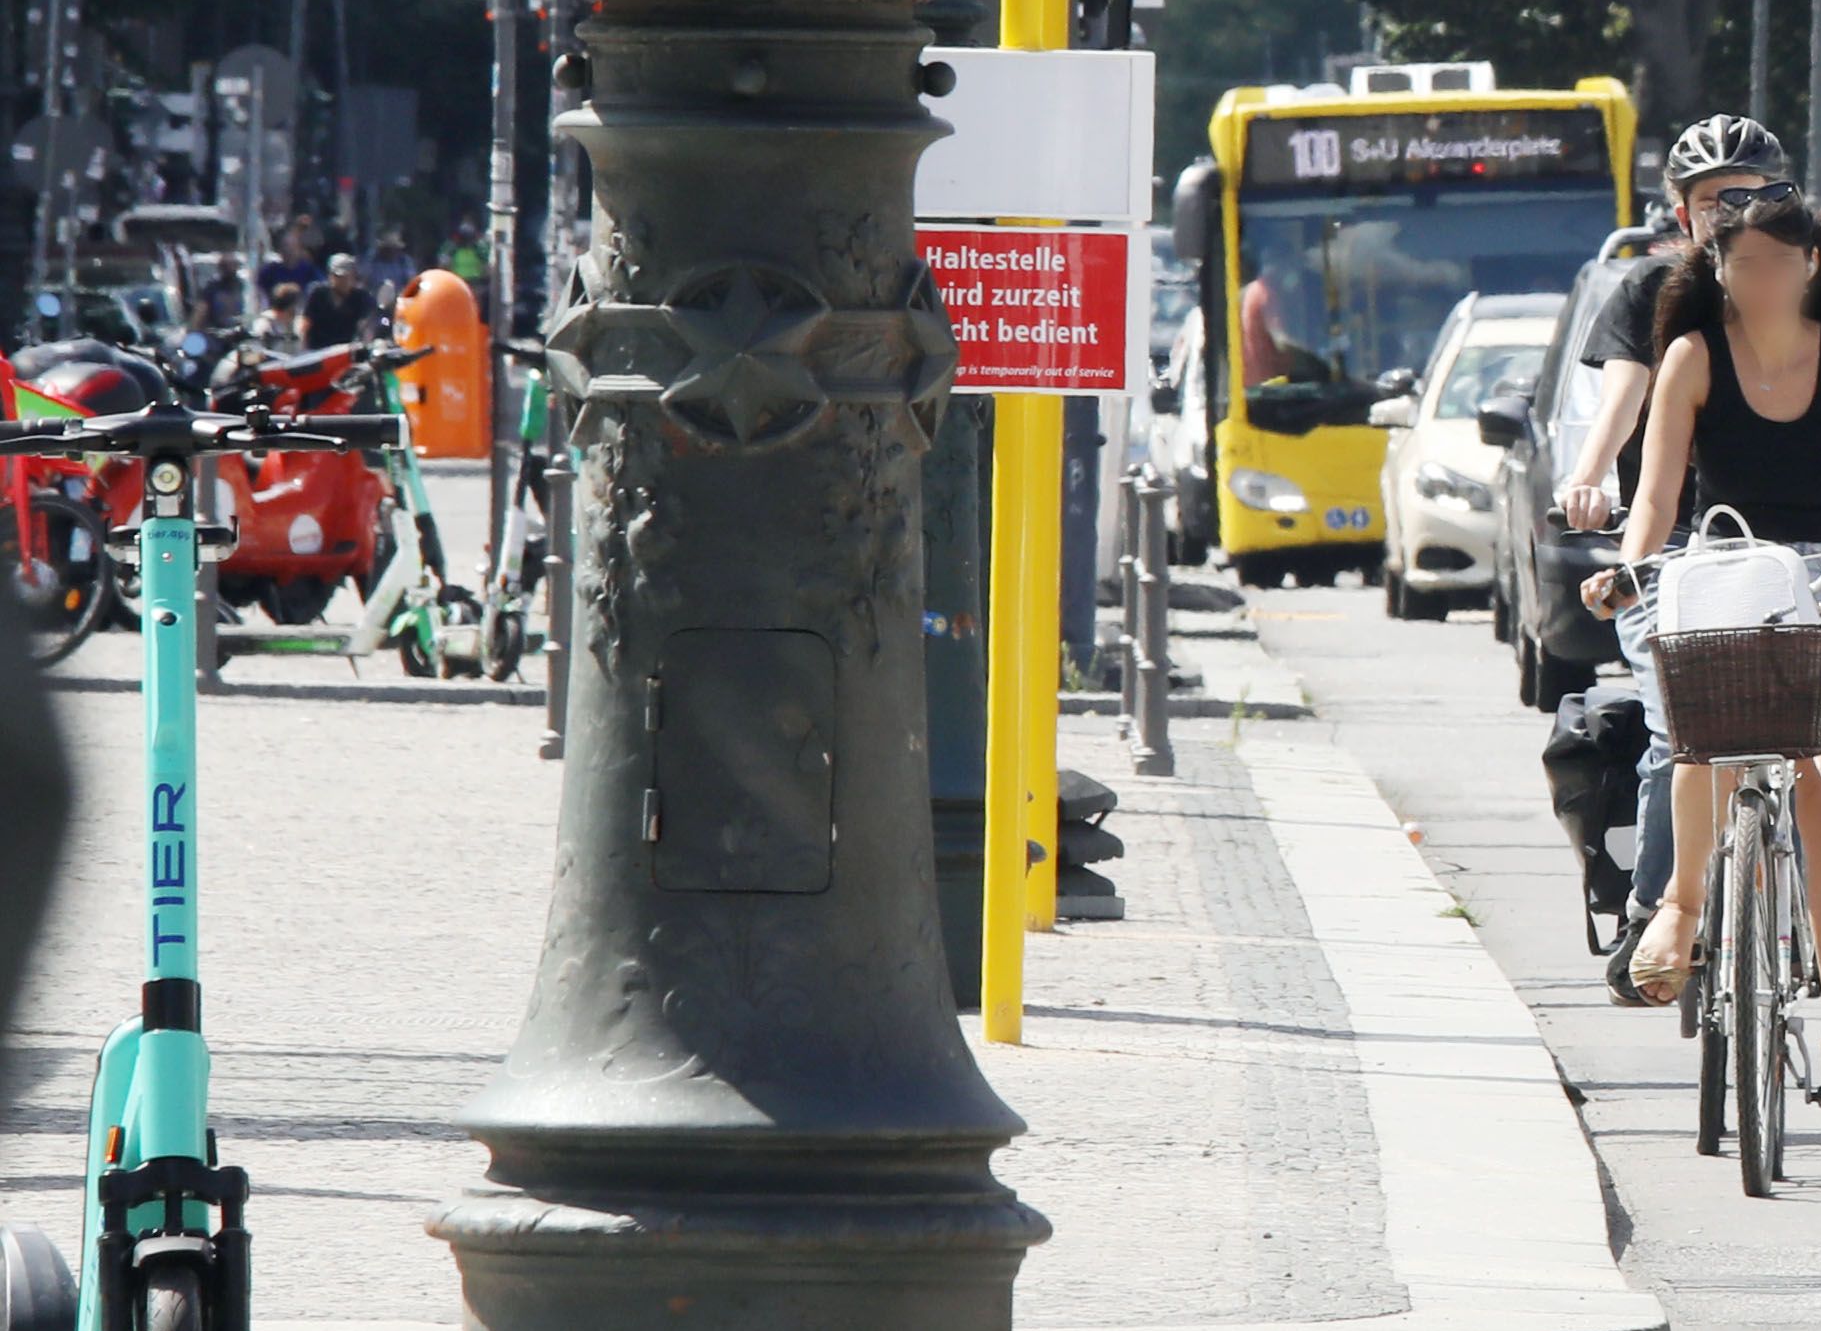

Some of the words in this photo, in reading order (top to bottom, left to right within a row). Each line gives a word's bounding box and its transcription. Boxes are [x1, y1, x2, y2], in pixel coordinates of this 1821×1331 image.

[1289, 130, 1341, 176] 100
[926, 245, 1066, 272] Haltestelle
[991, 283, 1081, 308] zurzeit
[951, 317, 990, 341] cht
[998, 318, 1098, 345] bedient
[153, 781, 186, 969] TIER
